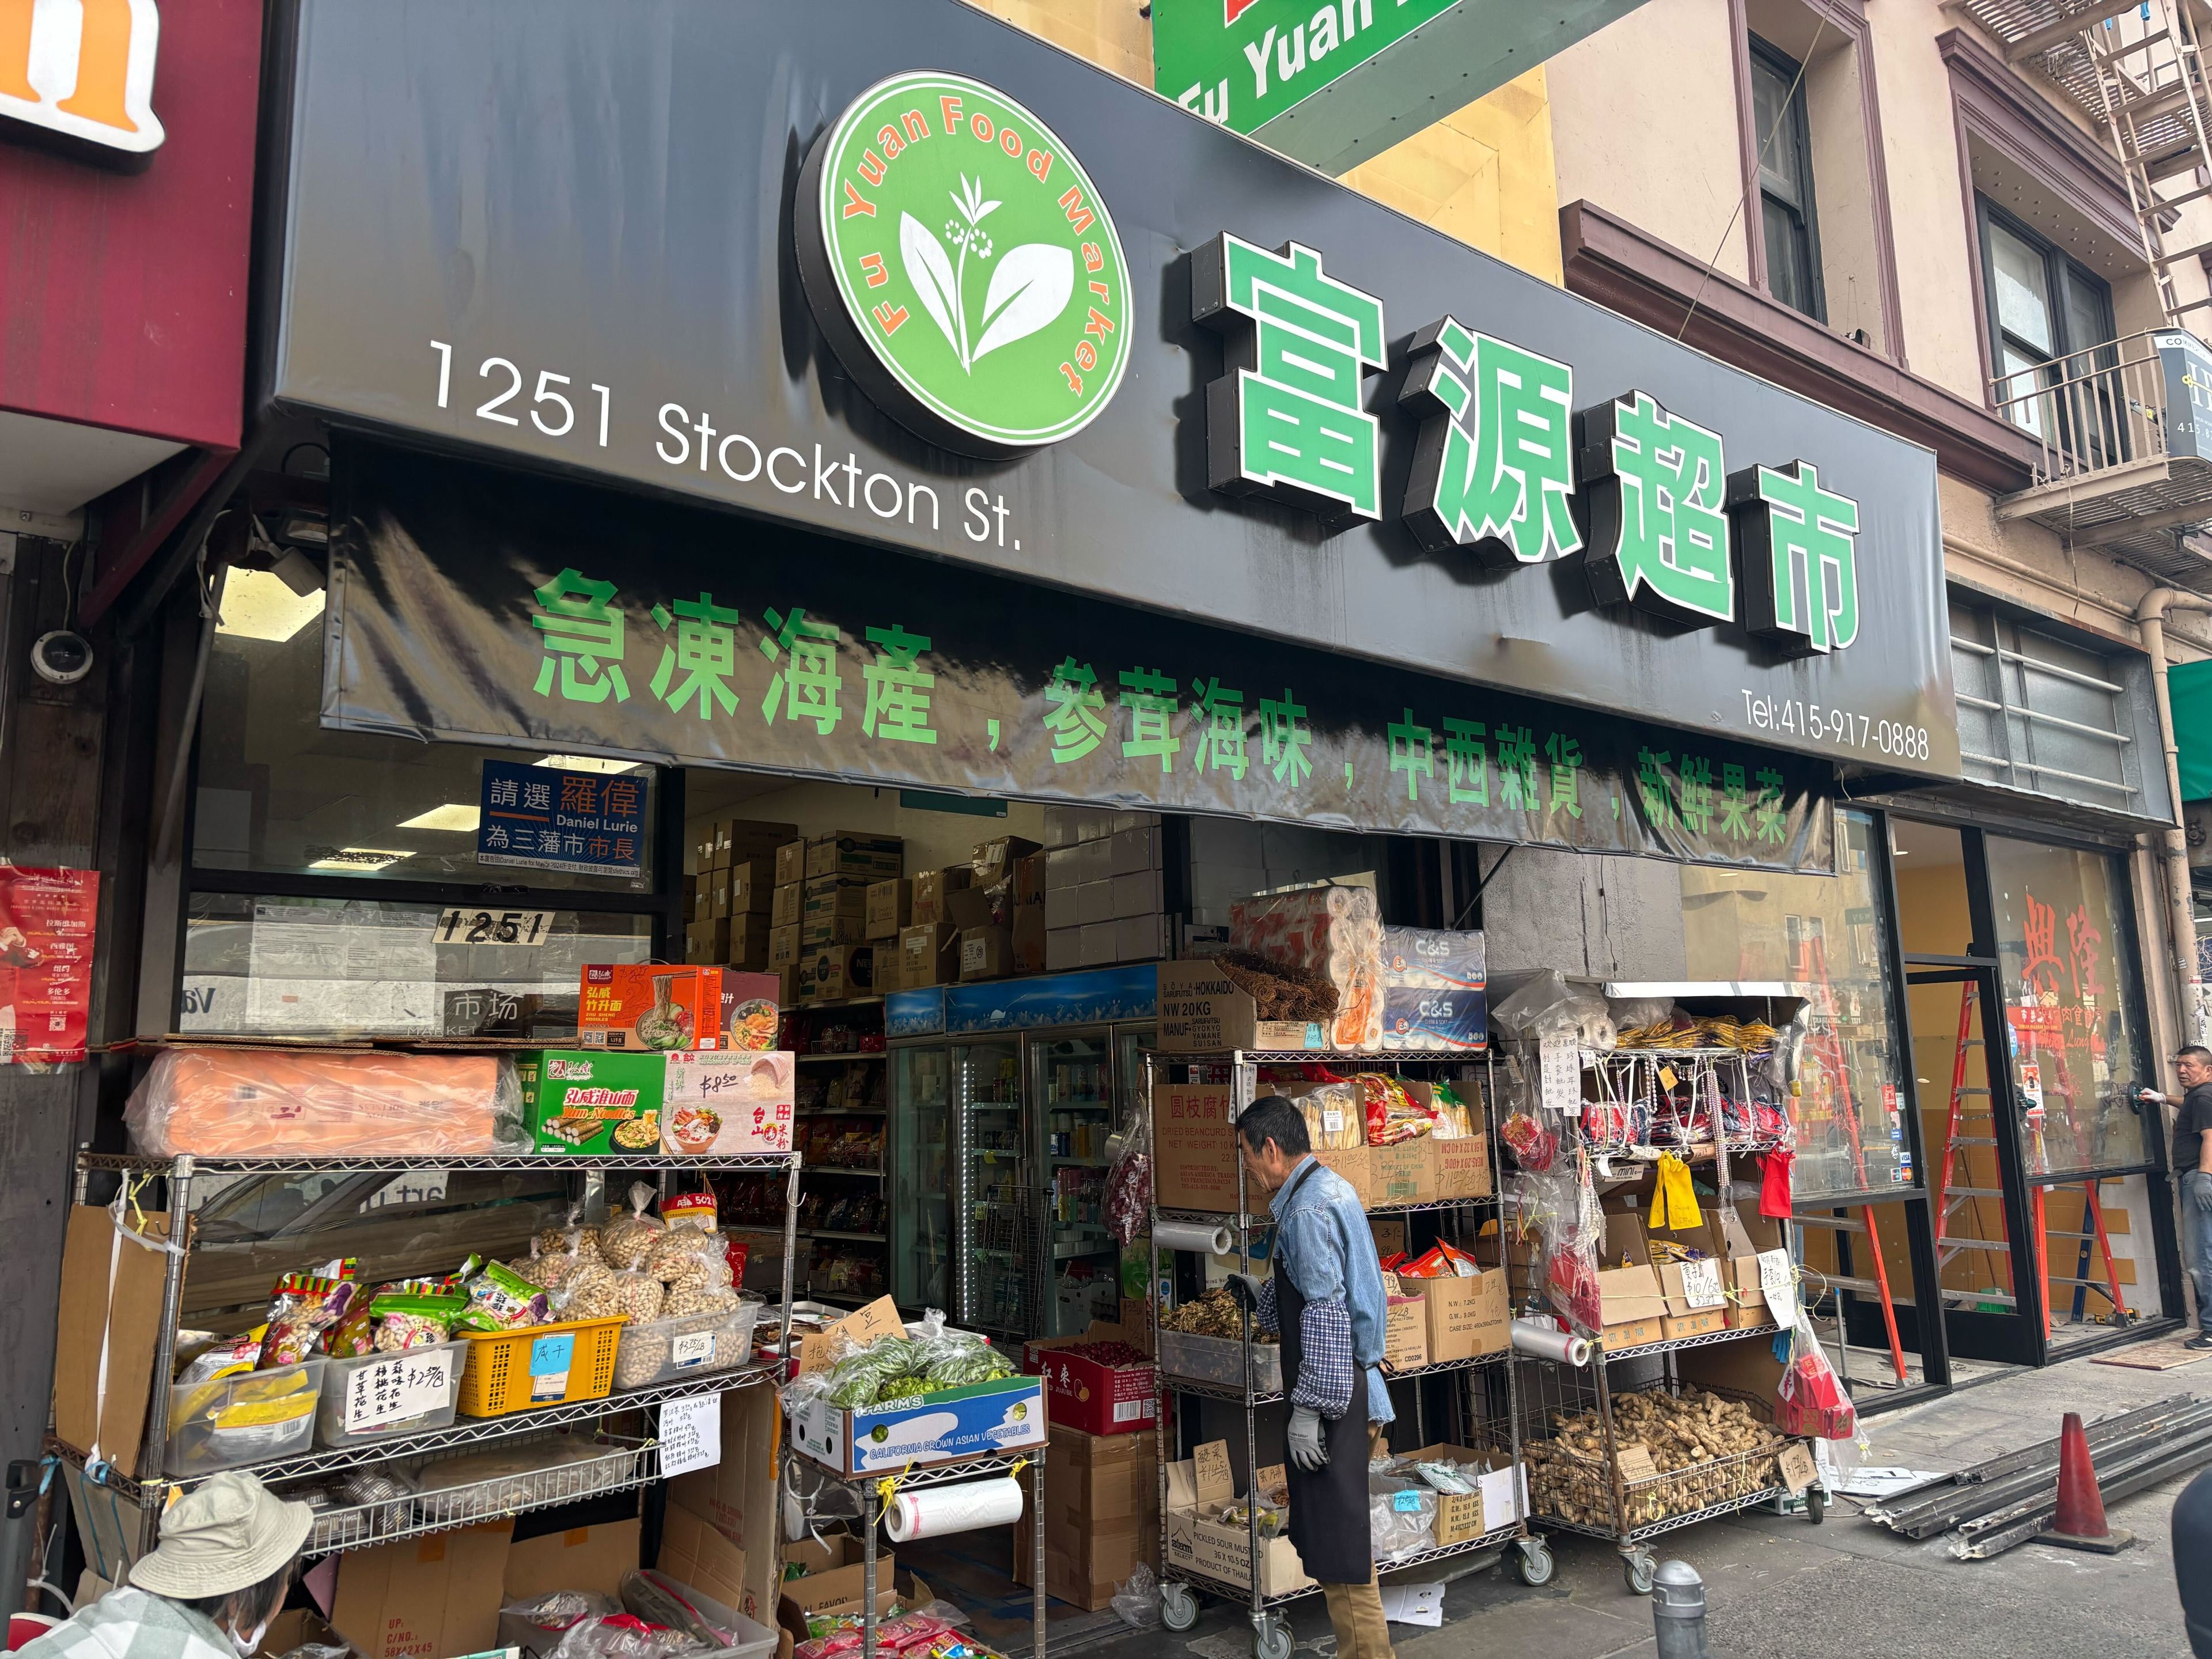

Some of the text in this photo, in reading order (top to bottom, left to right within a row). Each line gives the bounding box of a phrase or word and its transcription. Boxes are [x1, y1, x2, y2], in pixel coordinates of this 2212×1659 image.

[843, 95, 1115, 398] Fu Yuan Food Market
[430, 340, 1021, 551] 1251 Stockton St.
[1222, 229, 1862, 654] 富源超市
[1741, 690, 1930, 762] Tel:415-917-0888
[490, 775, 639, 818] 請選 羅偉
[556, 815, 638, 833] Daniel Lurie
[443, 910, 544, 944] 1251
[1415, 939, 1450, 956] C&S
[1163, 990, 1193, 998] SARUFUTSU
[1195, 980, 1234, 995] HOKKAIDO
[454, 992, 524, 1020] 市场
[585, 1000, 623, 1012] 竹升面
[1164, 1003, 1179, 1017] NW
[1419, 999, 1453, 1018] C&S
[407, 1026, 477, 1036] MARKET
[563, 1088, 639, 1107] 弘威淮山面
[1162, 1127, 1226, 1137] DRIED BEANCURD
[1169, 1140, 1181, 1149] NET
[1449, 1324, 1462, 1332] CASE
[1635, 1327, 1644, 1336] PAIR
[1404, 1354, 1422, 1362] CD0296
[869, 1424, 1031, 1460] CALIFORNIA GROWN ASIAN VEGETABLES
[1194, 1531, 1216, 1545] PICKLED
[1217, 1537, 1233, 1551] SOUR
[1195, 1556, 1231, 1574] PRODUCT OF
[1214, 1550, 1221, 1559] 36
[1228, 1555, 1239, 1565] 10.5
